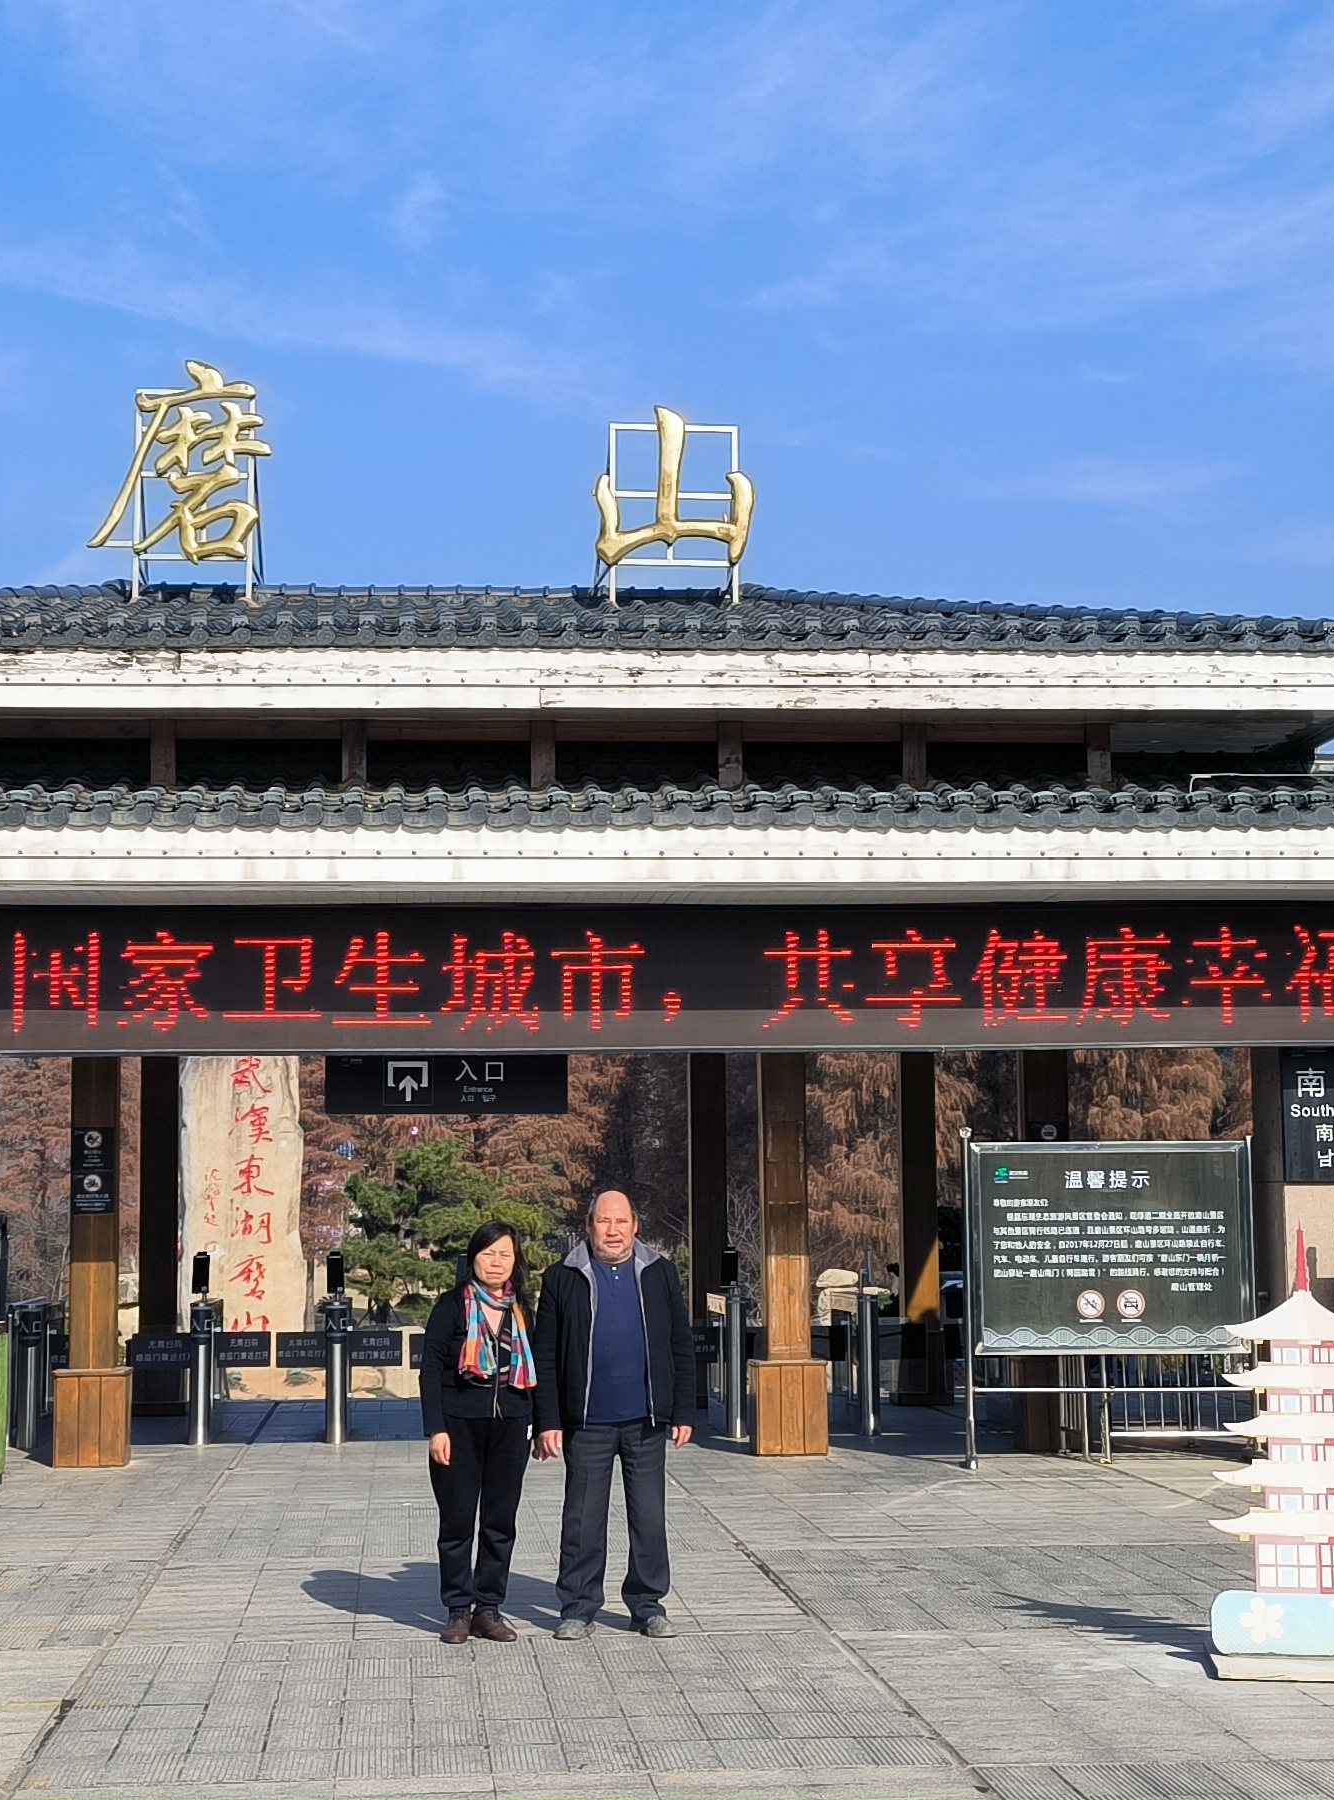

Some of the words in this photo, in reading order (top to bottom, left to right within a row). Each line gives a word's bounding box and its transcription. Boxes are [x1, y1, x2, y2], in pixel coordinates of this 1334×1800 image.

[87, 359, 755, 565] 磨山
[455, 1059, 505, 1082] 入口
[1290, 1104, 1334, 1117] South
[1064, 1170, 1151, 1189] 温馨提示
[19, 1320, 42, 1333] 入口
[326, 1319, 348, 1331] 入口
